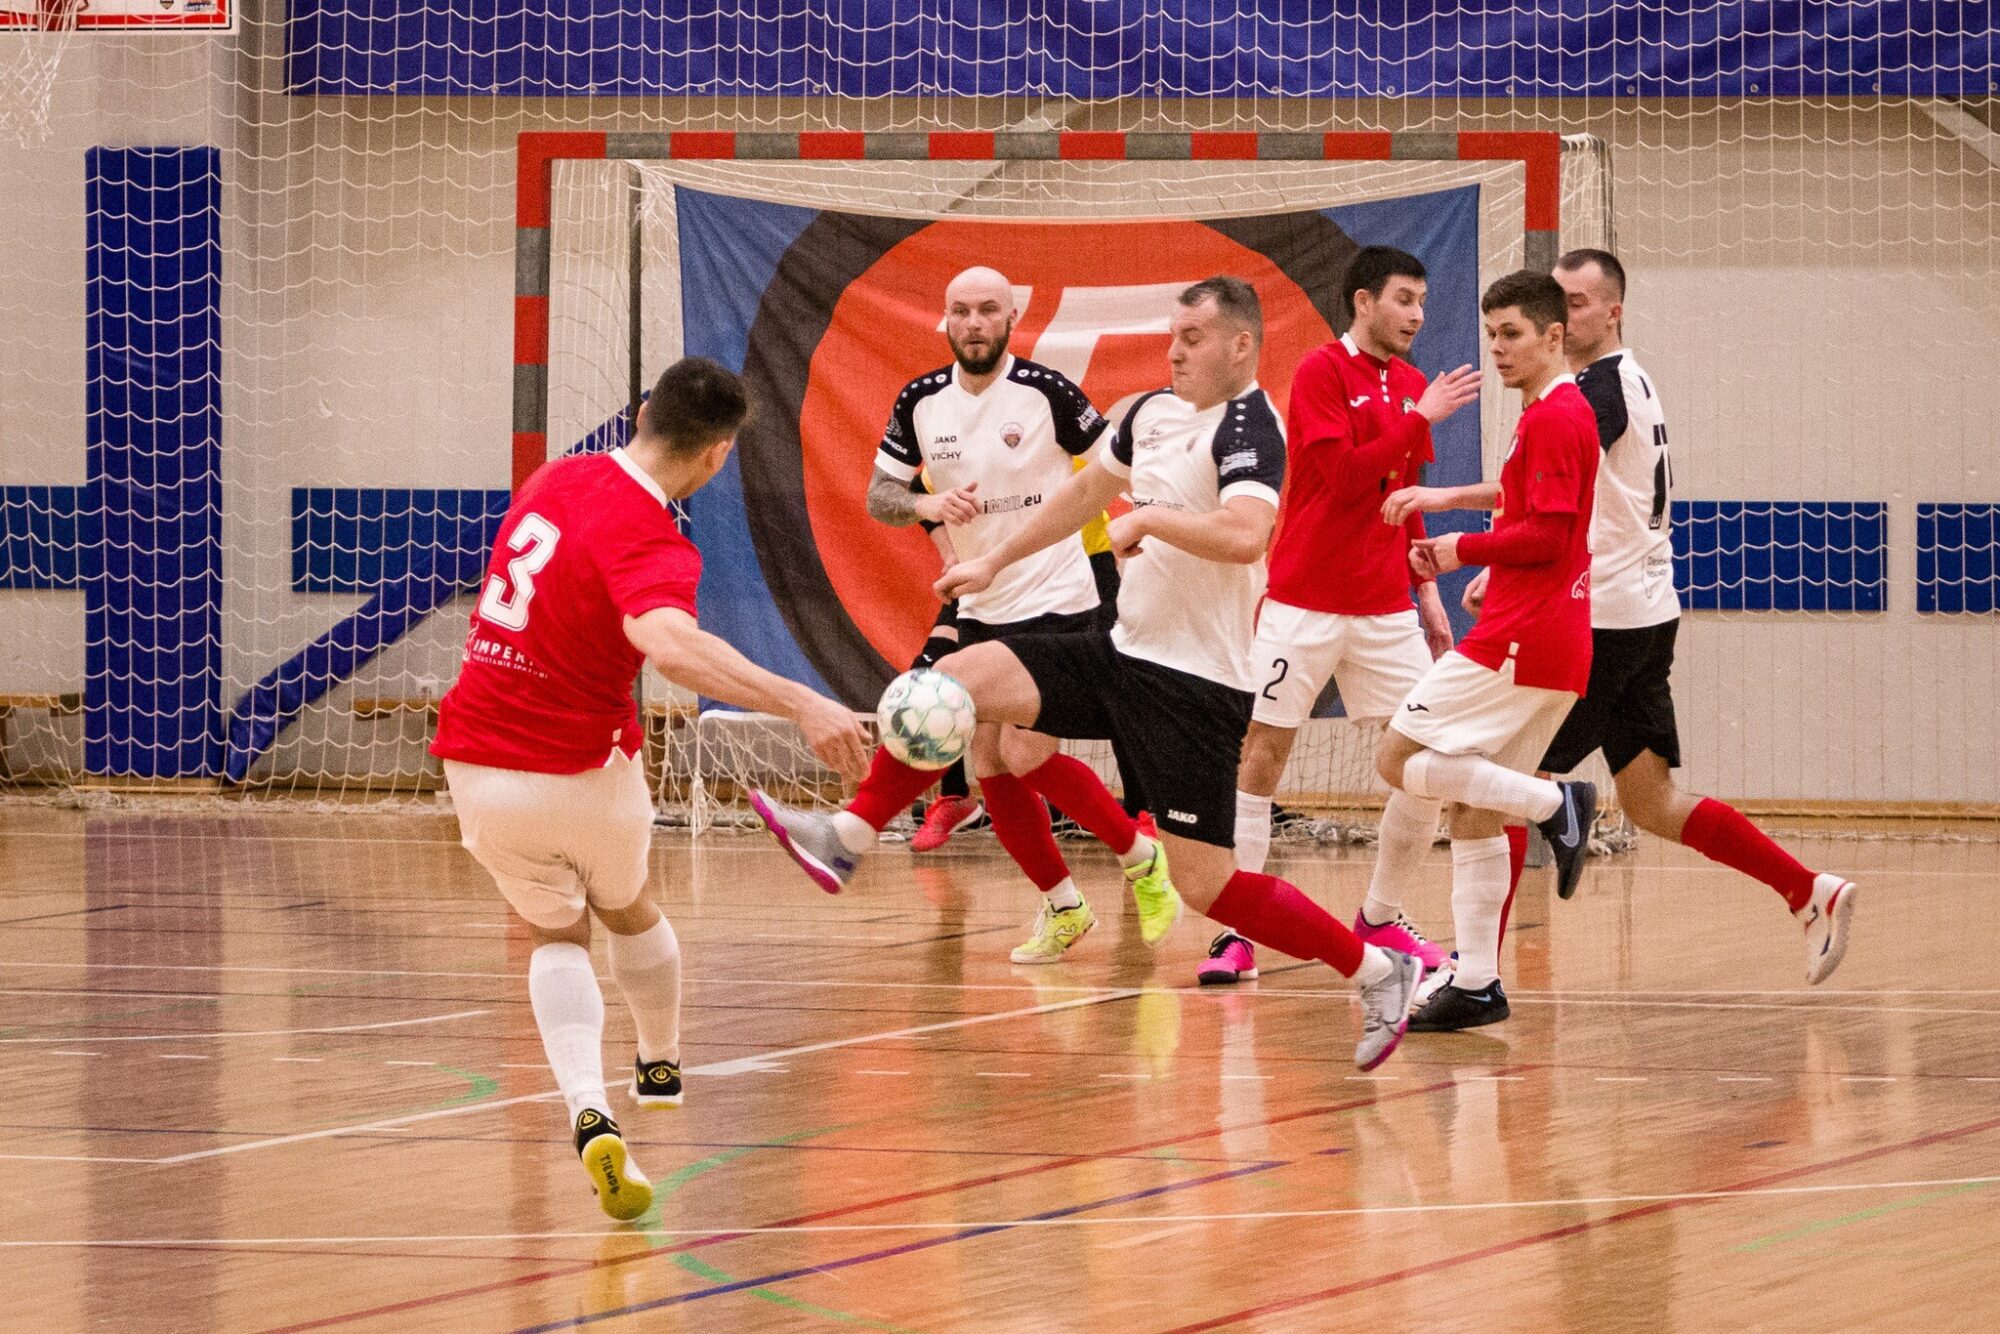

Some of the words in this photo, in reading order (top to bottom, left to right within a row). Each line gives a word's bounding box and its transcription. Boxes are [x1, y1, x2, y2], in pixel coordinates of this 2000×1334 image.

[934, 435, 957, 444] JAKO
[930, 451, 962, 461] VICHY
[479, 512, 561, 632] 3
[1262, 657, 1289, 702] 2
[1167, 809, 1198, 824] JAKO
